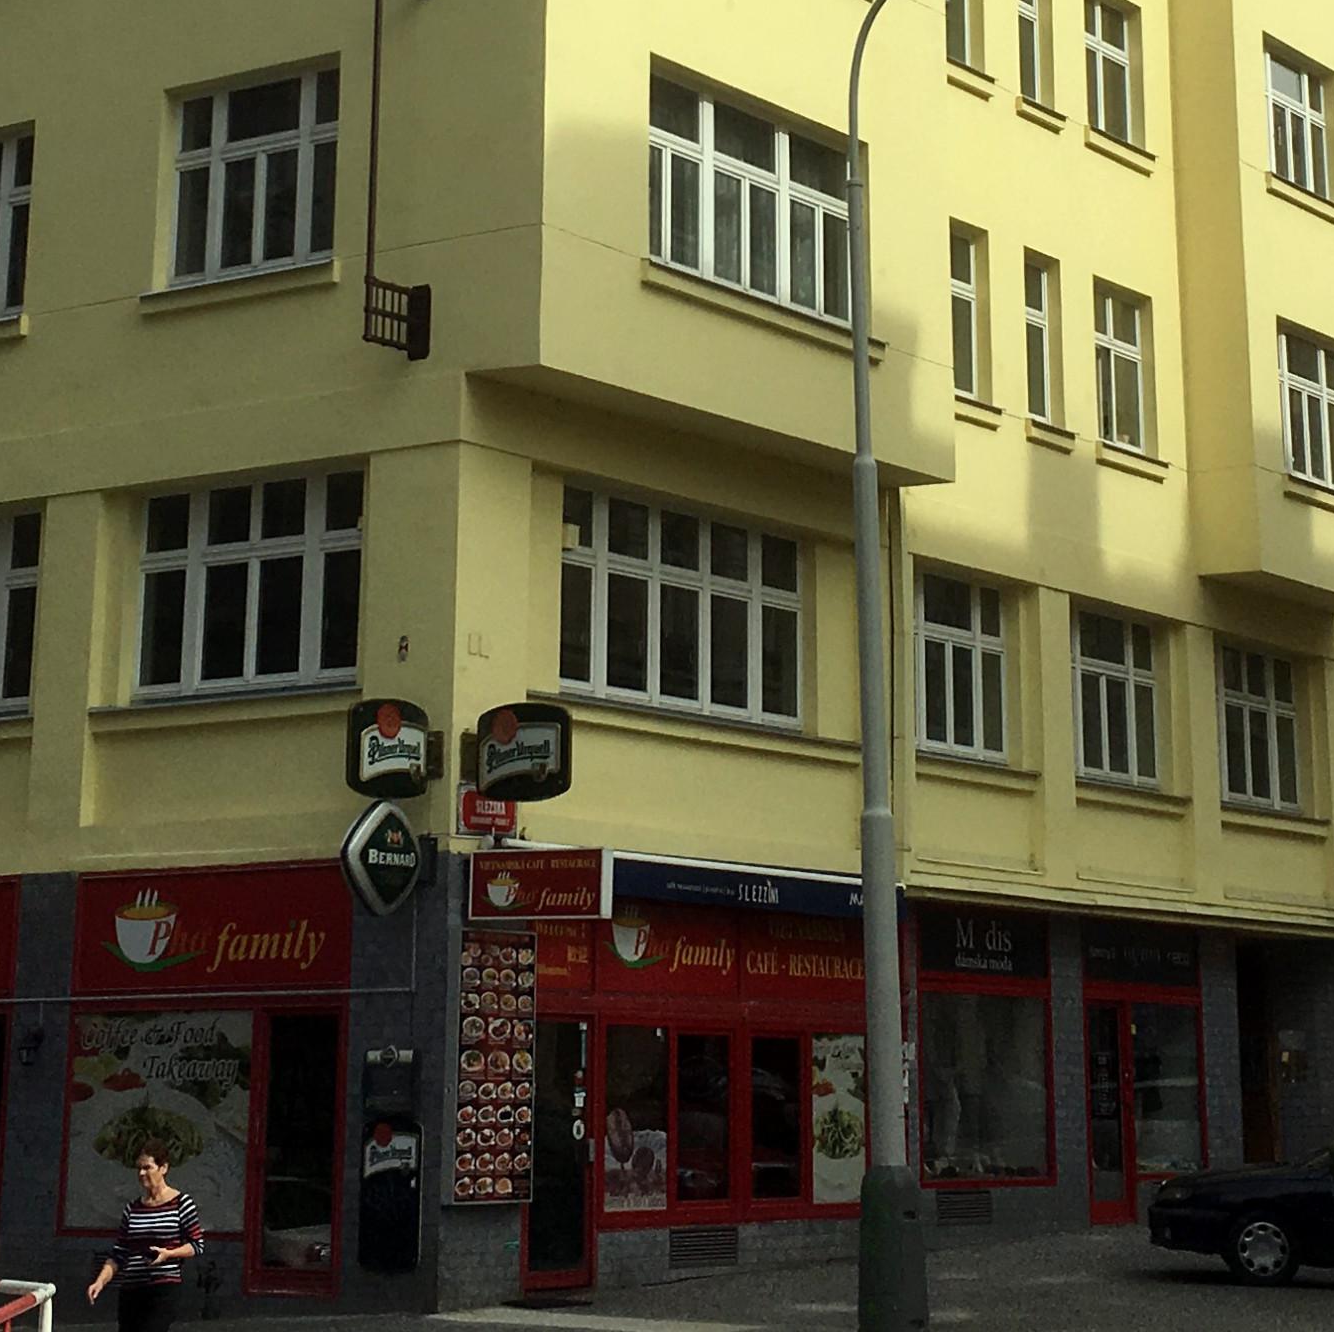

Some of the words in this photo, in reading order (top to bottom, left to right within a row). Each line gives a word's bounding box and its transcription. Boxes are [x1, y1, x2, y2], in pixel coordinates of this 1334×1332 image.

[368, 849, 416, 868] BERNARD
[533, 885, 596, 912] family
[206, 918, 327, 973] family
[669, 934, 736, 976] family
[745, 946, 779, 976] CAFÉ
[788, 953, 865, 981] RESTAURACE
[82, 1019, 138, 1052] Coffee
[168, 1018, 221, 1046] Food
[144, 1054, 241, 1089] Takeaway
